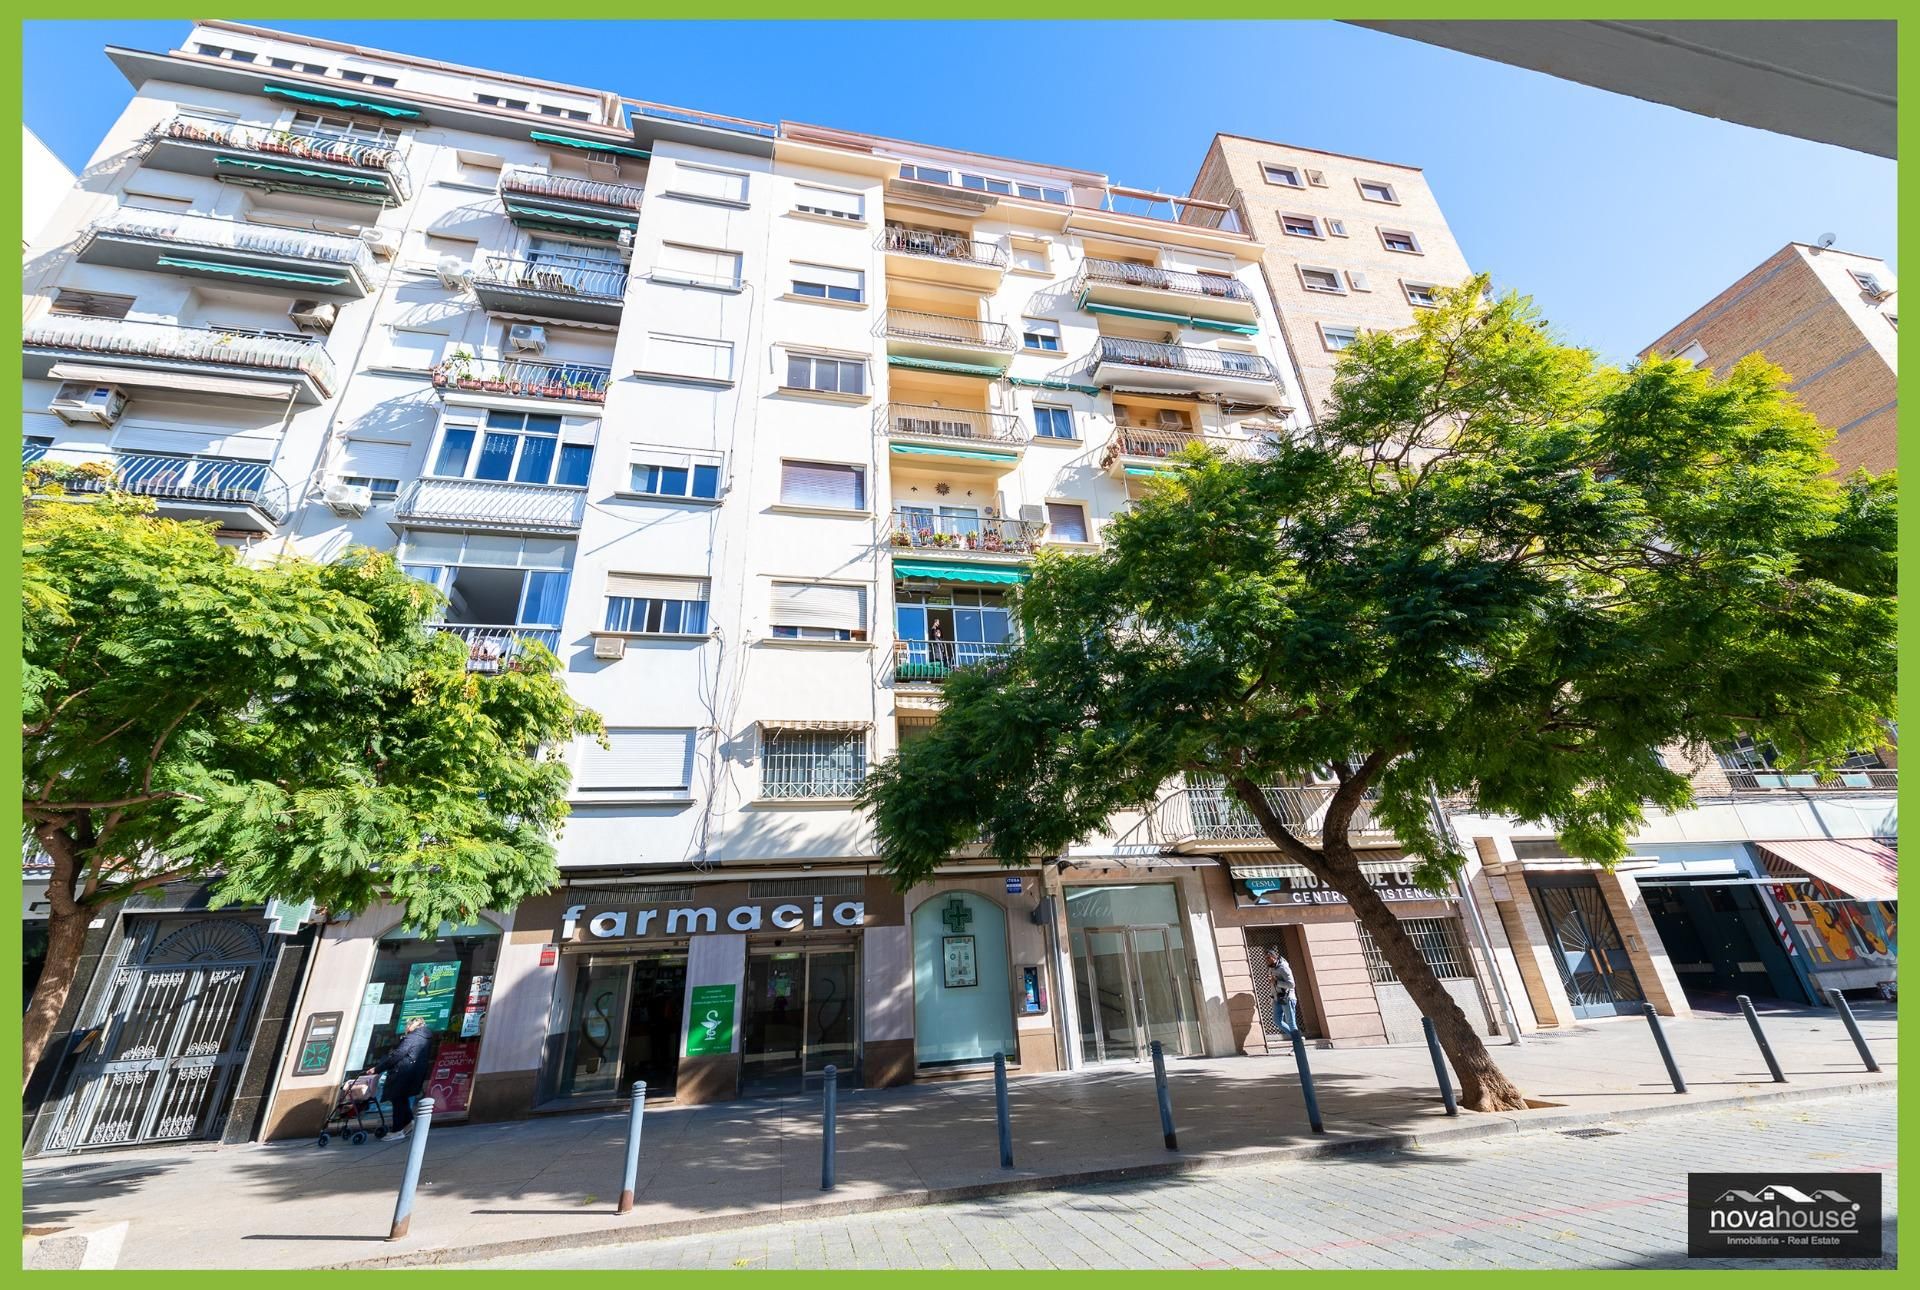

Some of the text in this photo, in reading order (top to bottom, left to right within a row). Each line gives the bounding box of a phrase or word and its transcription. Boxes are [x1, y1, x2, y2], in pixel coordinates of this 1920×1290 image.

[1251, 880, 1276, 888] CESMA
[1374, 886, 1457, 900] ISTENCIAL
[561, 896, 865, 939] farmacia
